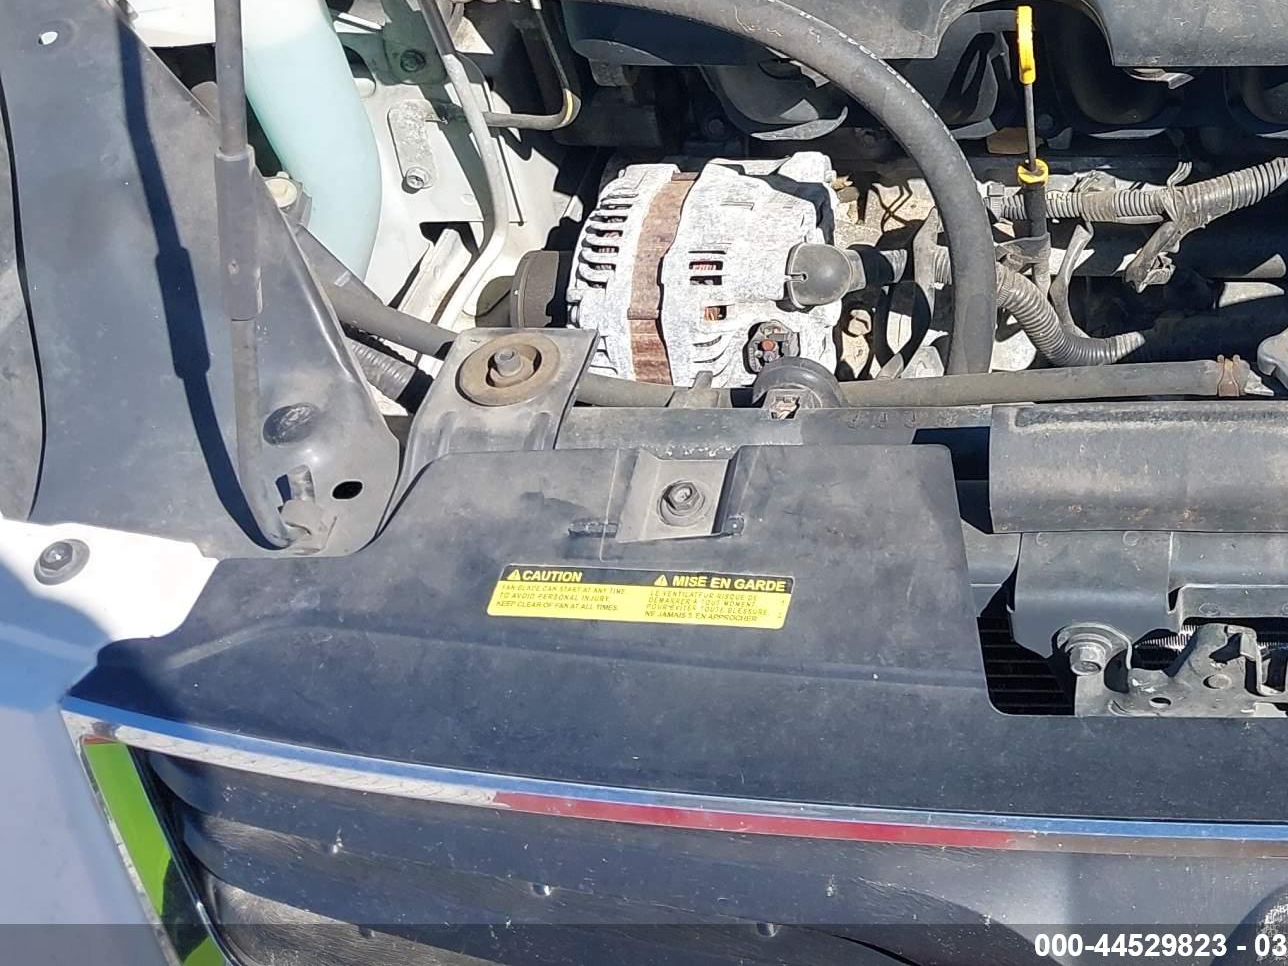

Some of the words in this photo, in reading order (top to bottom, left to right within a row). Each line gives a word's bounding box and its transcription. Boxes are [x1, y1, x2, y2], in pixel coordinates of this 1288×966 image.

[523, 570, 582, 582] CAUTION
[672, 575, 707, 588] MISE
[710, 577, 732, 589] EN
[734, 578, 787, 592] GARDE
